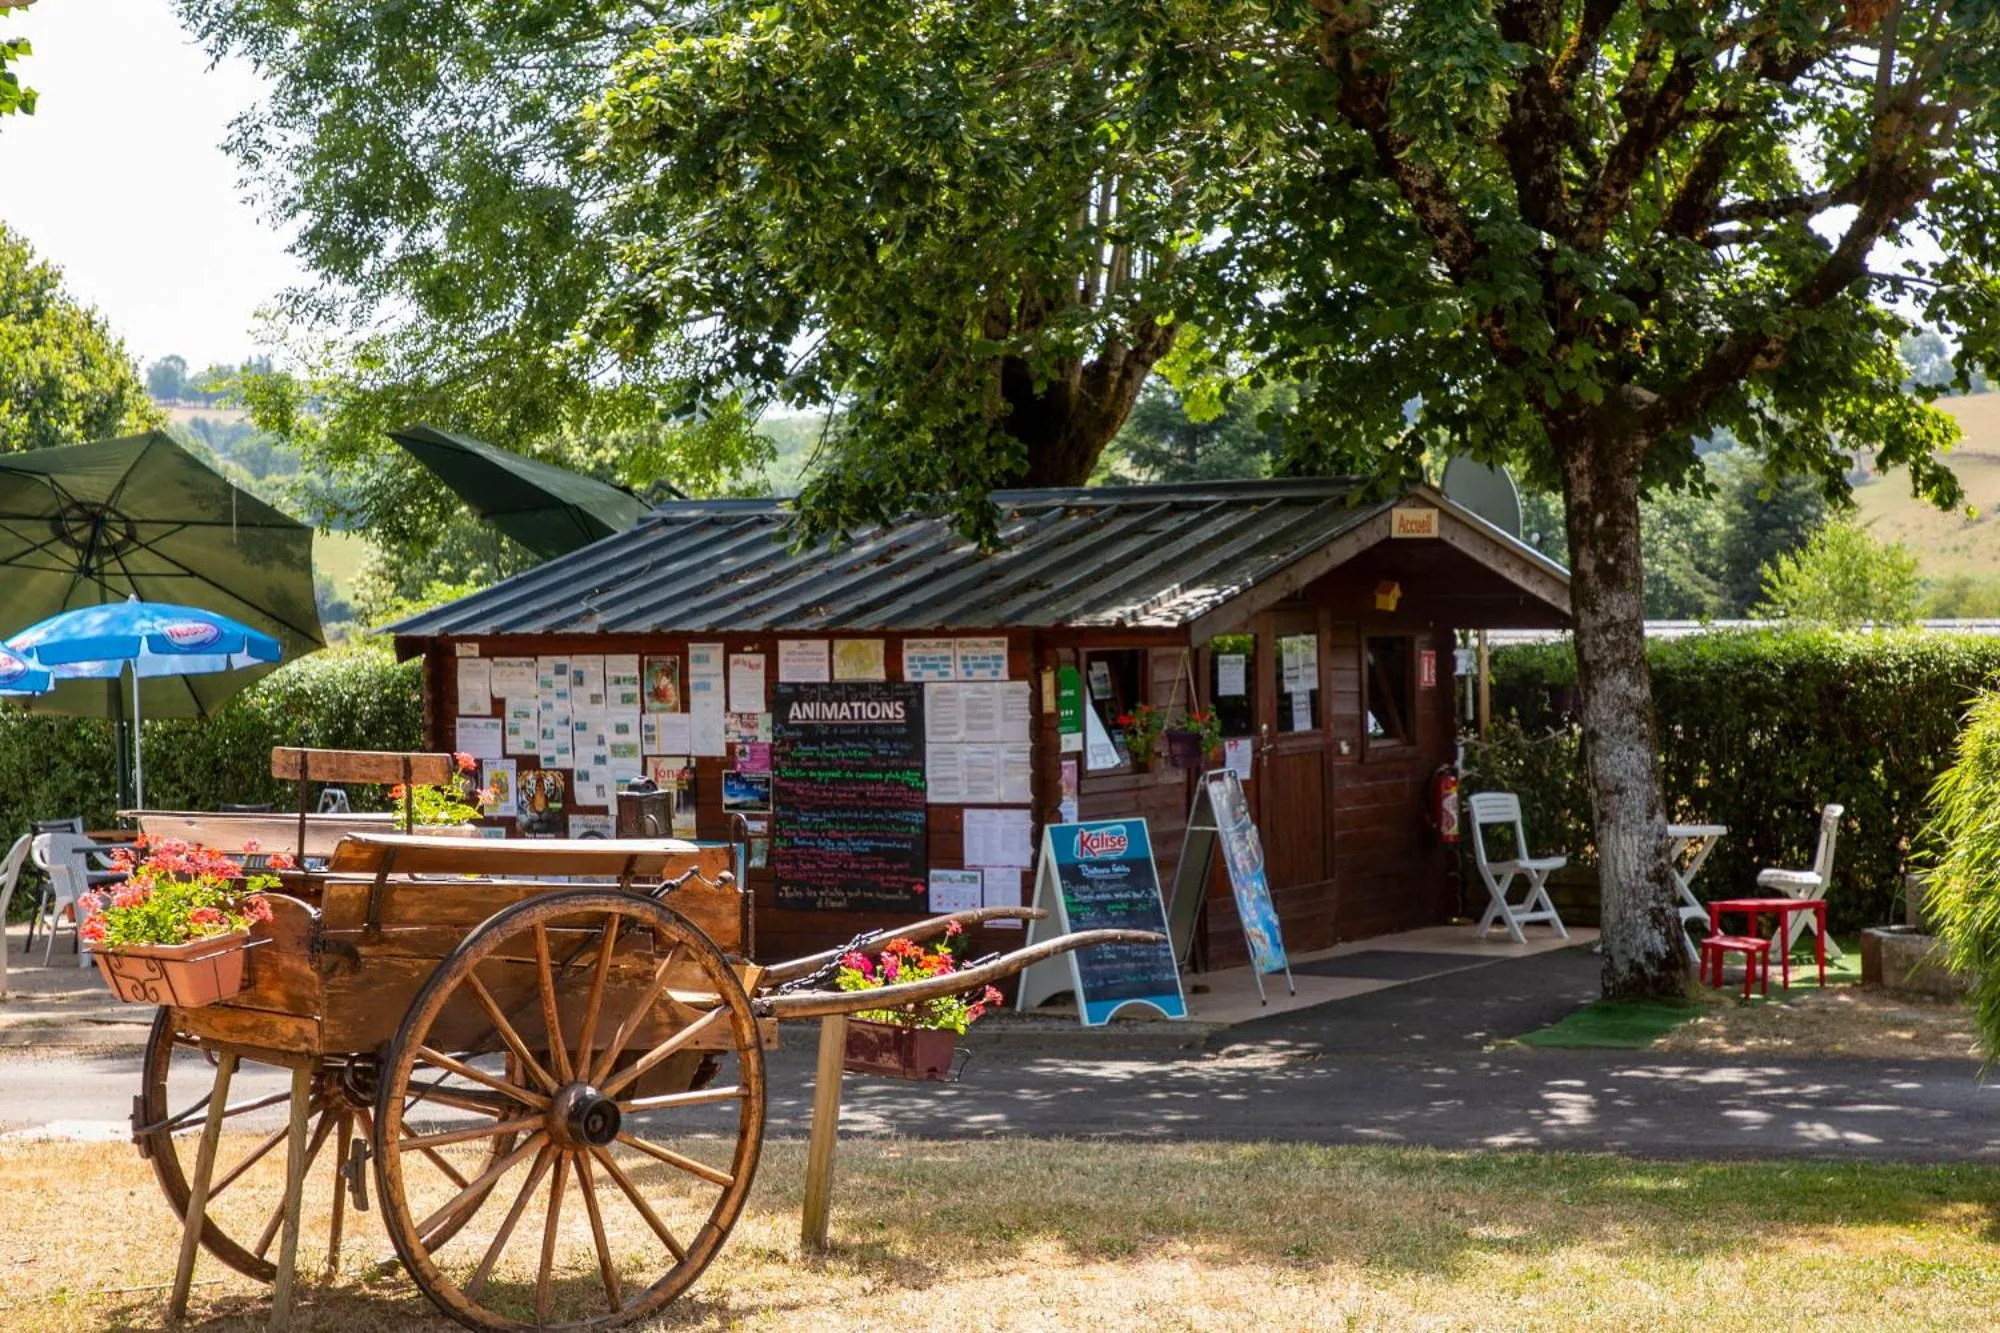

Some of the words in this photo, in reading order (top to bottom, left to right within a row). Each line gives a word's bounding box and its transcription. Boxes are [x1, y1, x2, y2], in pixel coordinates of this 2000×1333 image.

[1399, 513, 1433, 534] Accueil
[789, 701, 906, 720] ANIMATIONS
[1080, 831, 1127, 858] Kalise
